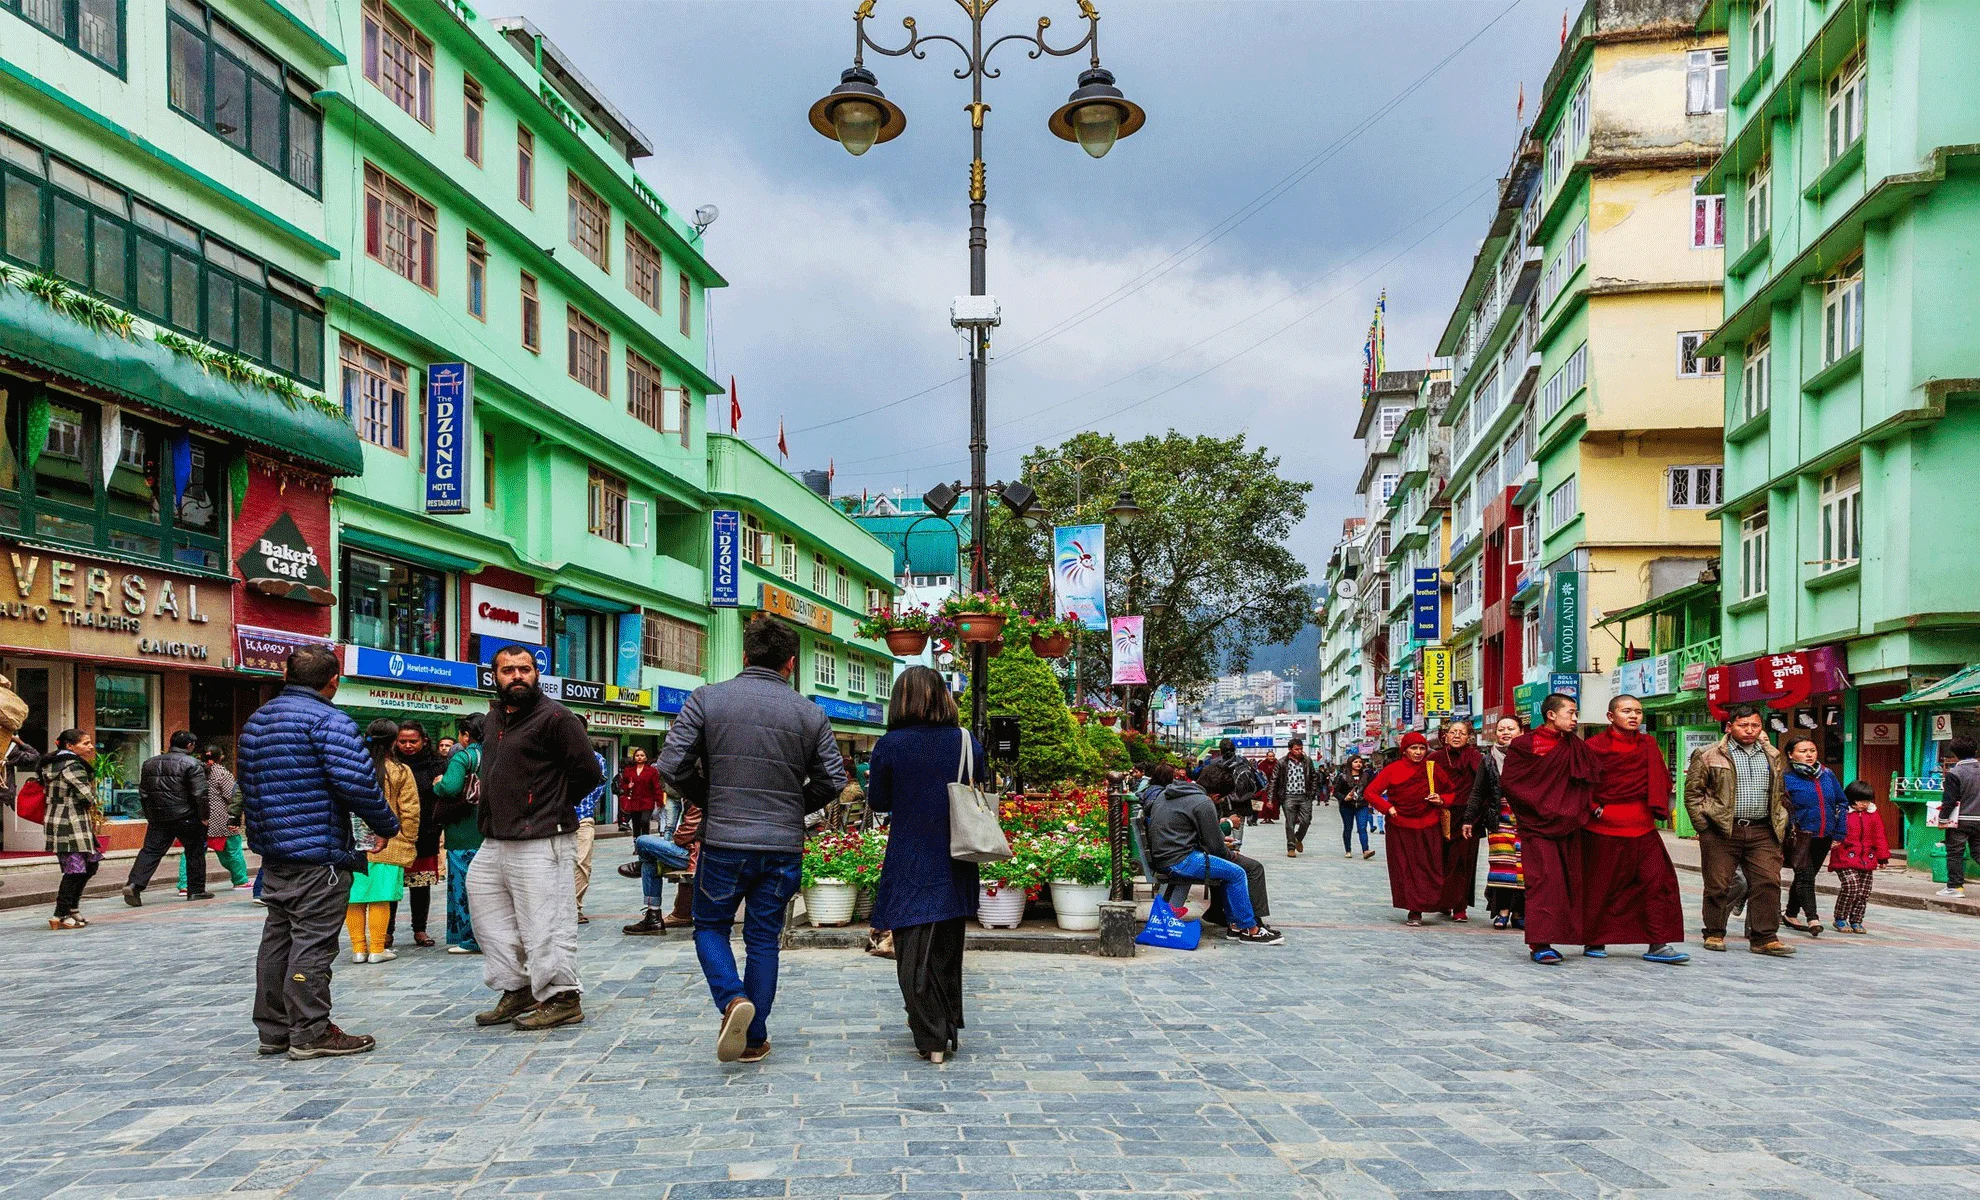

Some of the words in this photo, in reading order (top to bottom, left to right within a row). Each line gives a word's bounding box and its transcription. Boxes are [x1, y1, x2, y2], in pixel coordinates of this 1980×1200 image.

[436, 402, 454, 479] DZONG
[432, 483, 456, 491] HOTEL
[427, 499, 461, 507] RESTAURANT
[259, 539, 318, 567] Baker's
[719, 535, 732, 585] DZONG
[266, 556, 308, 579] Café
[0, 601, 49, 622] AUTO
[60, 607, 142, 634] TRADERS
[477, 602, 520, 625] Canon
[1563, 597, 1575, 664] WOODLAND
[137, 637, 209, 660] GANGTOK
[391, 655, 403, 677] hp
[406, 663, 452, 677] Hewlett-Packard
[1433, 653, 1445, 686] house
[1770, 654, 1797, 667] कैफे
[1772, 664, 1804, 678] कॉफी
[566, 683, 600, 699] SONY
[1774, 678, 1784, 689] डे
[369, 689, 389, 698] HARI
[389, 691, 405, 700] RAM
[425, 695, 439, 704] LAL
[441, 697, 463, 706] SARDA
[619, 687, 640, 703] Nikon
[1433, 691, 1445, 710] roll
[407, 702, 433, 710] STUDENT
[594, 711, 645, 727] CONVERSE
